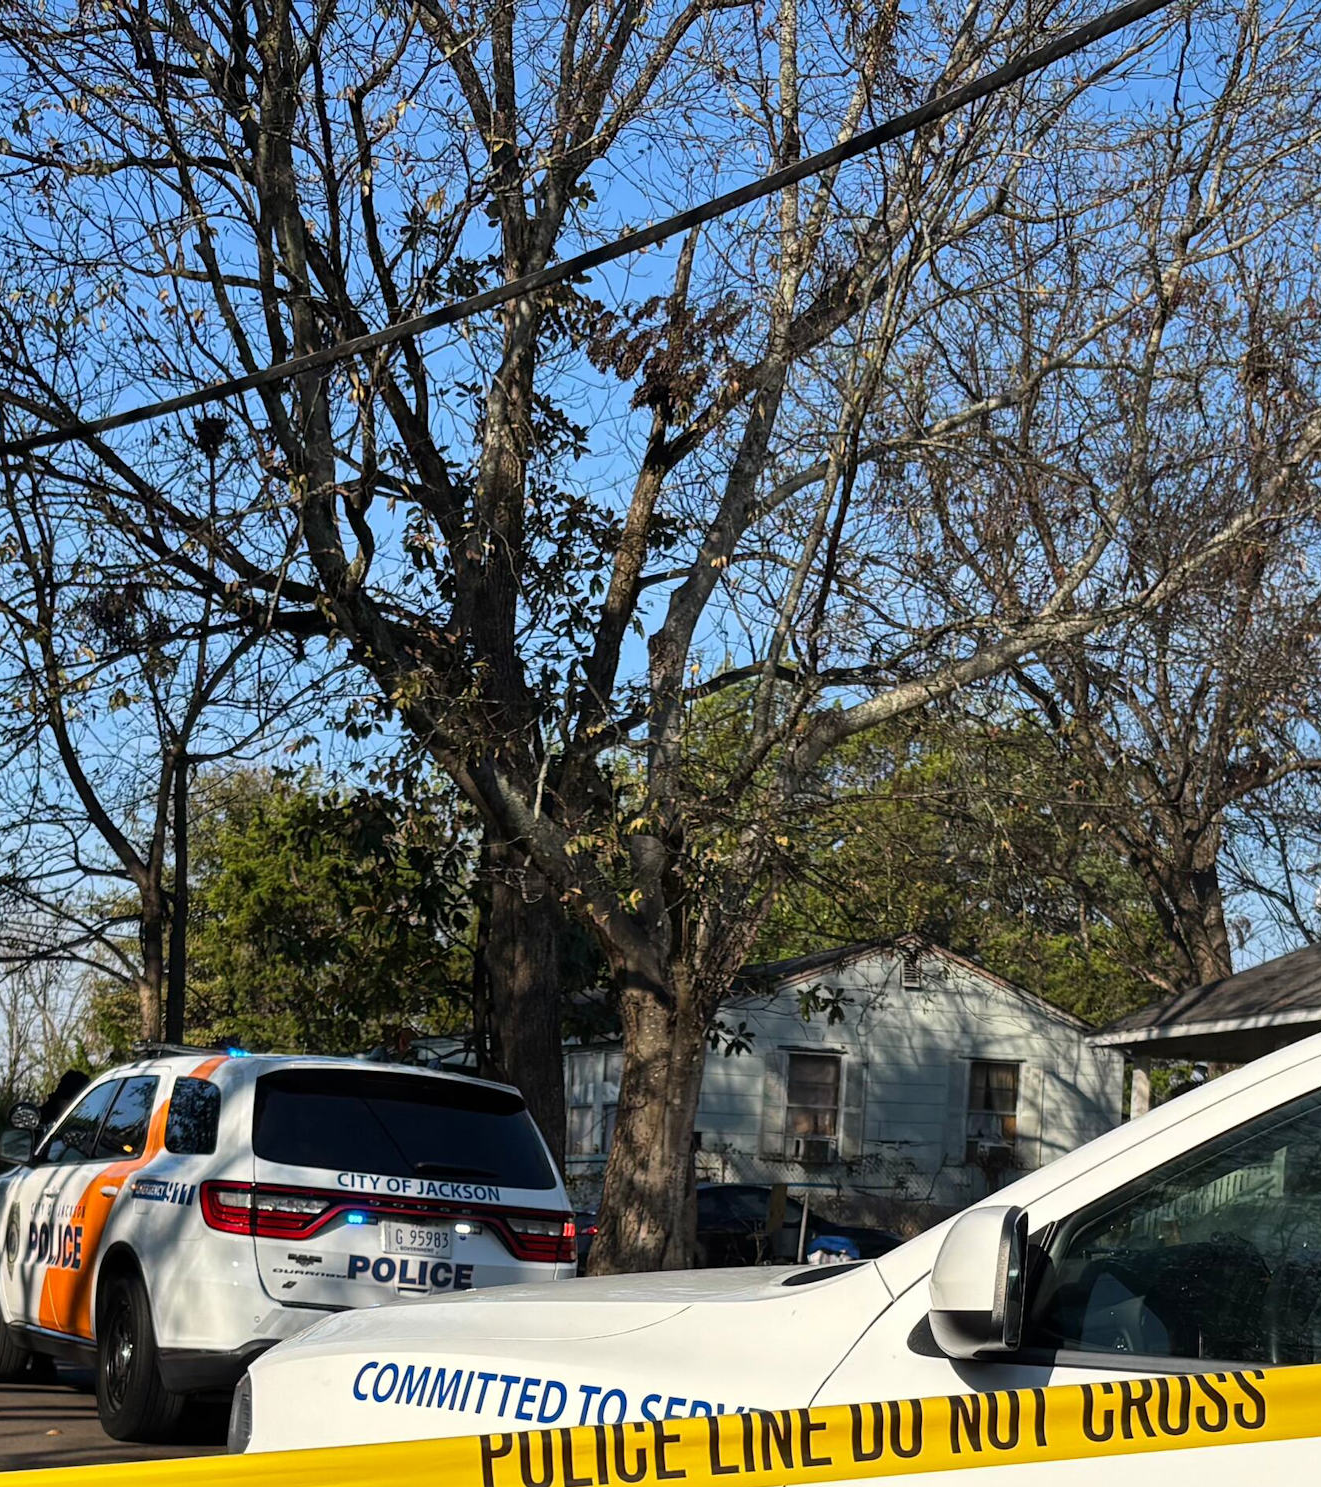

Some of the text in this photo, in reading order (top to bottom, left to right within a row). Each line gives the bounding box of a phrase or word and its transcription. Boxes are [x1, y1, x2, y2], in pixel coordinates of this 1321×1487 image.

[166, 1181, 190, 1205] 911
[337, 1172, 501, 1201] CITY OF JACKSON
[28, 1222, 84, 1269] POLICE
[395, 1228, 449, 1249] G 95983
[347, 1254, 474, 1290] POLICE
[353, 1361, 567, 1424] COMMITTED
[578, 1384, 628, 1426] TO
[706, 1408, 833, 1475] LINE
[848, 1398, 923, 1462] DO
[947, 1387, 1048, 1454] NOT
[1080, 1370, 1267, 1443] CROSS
